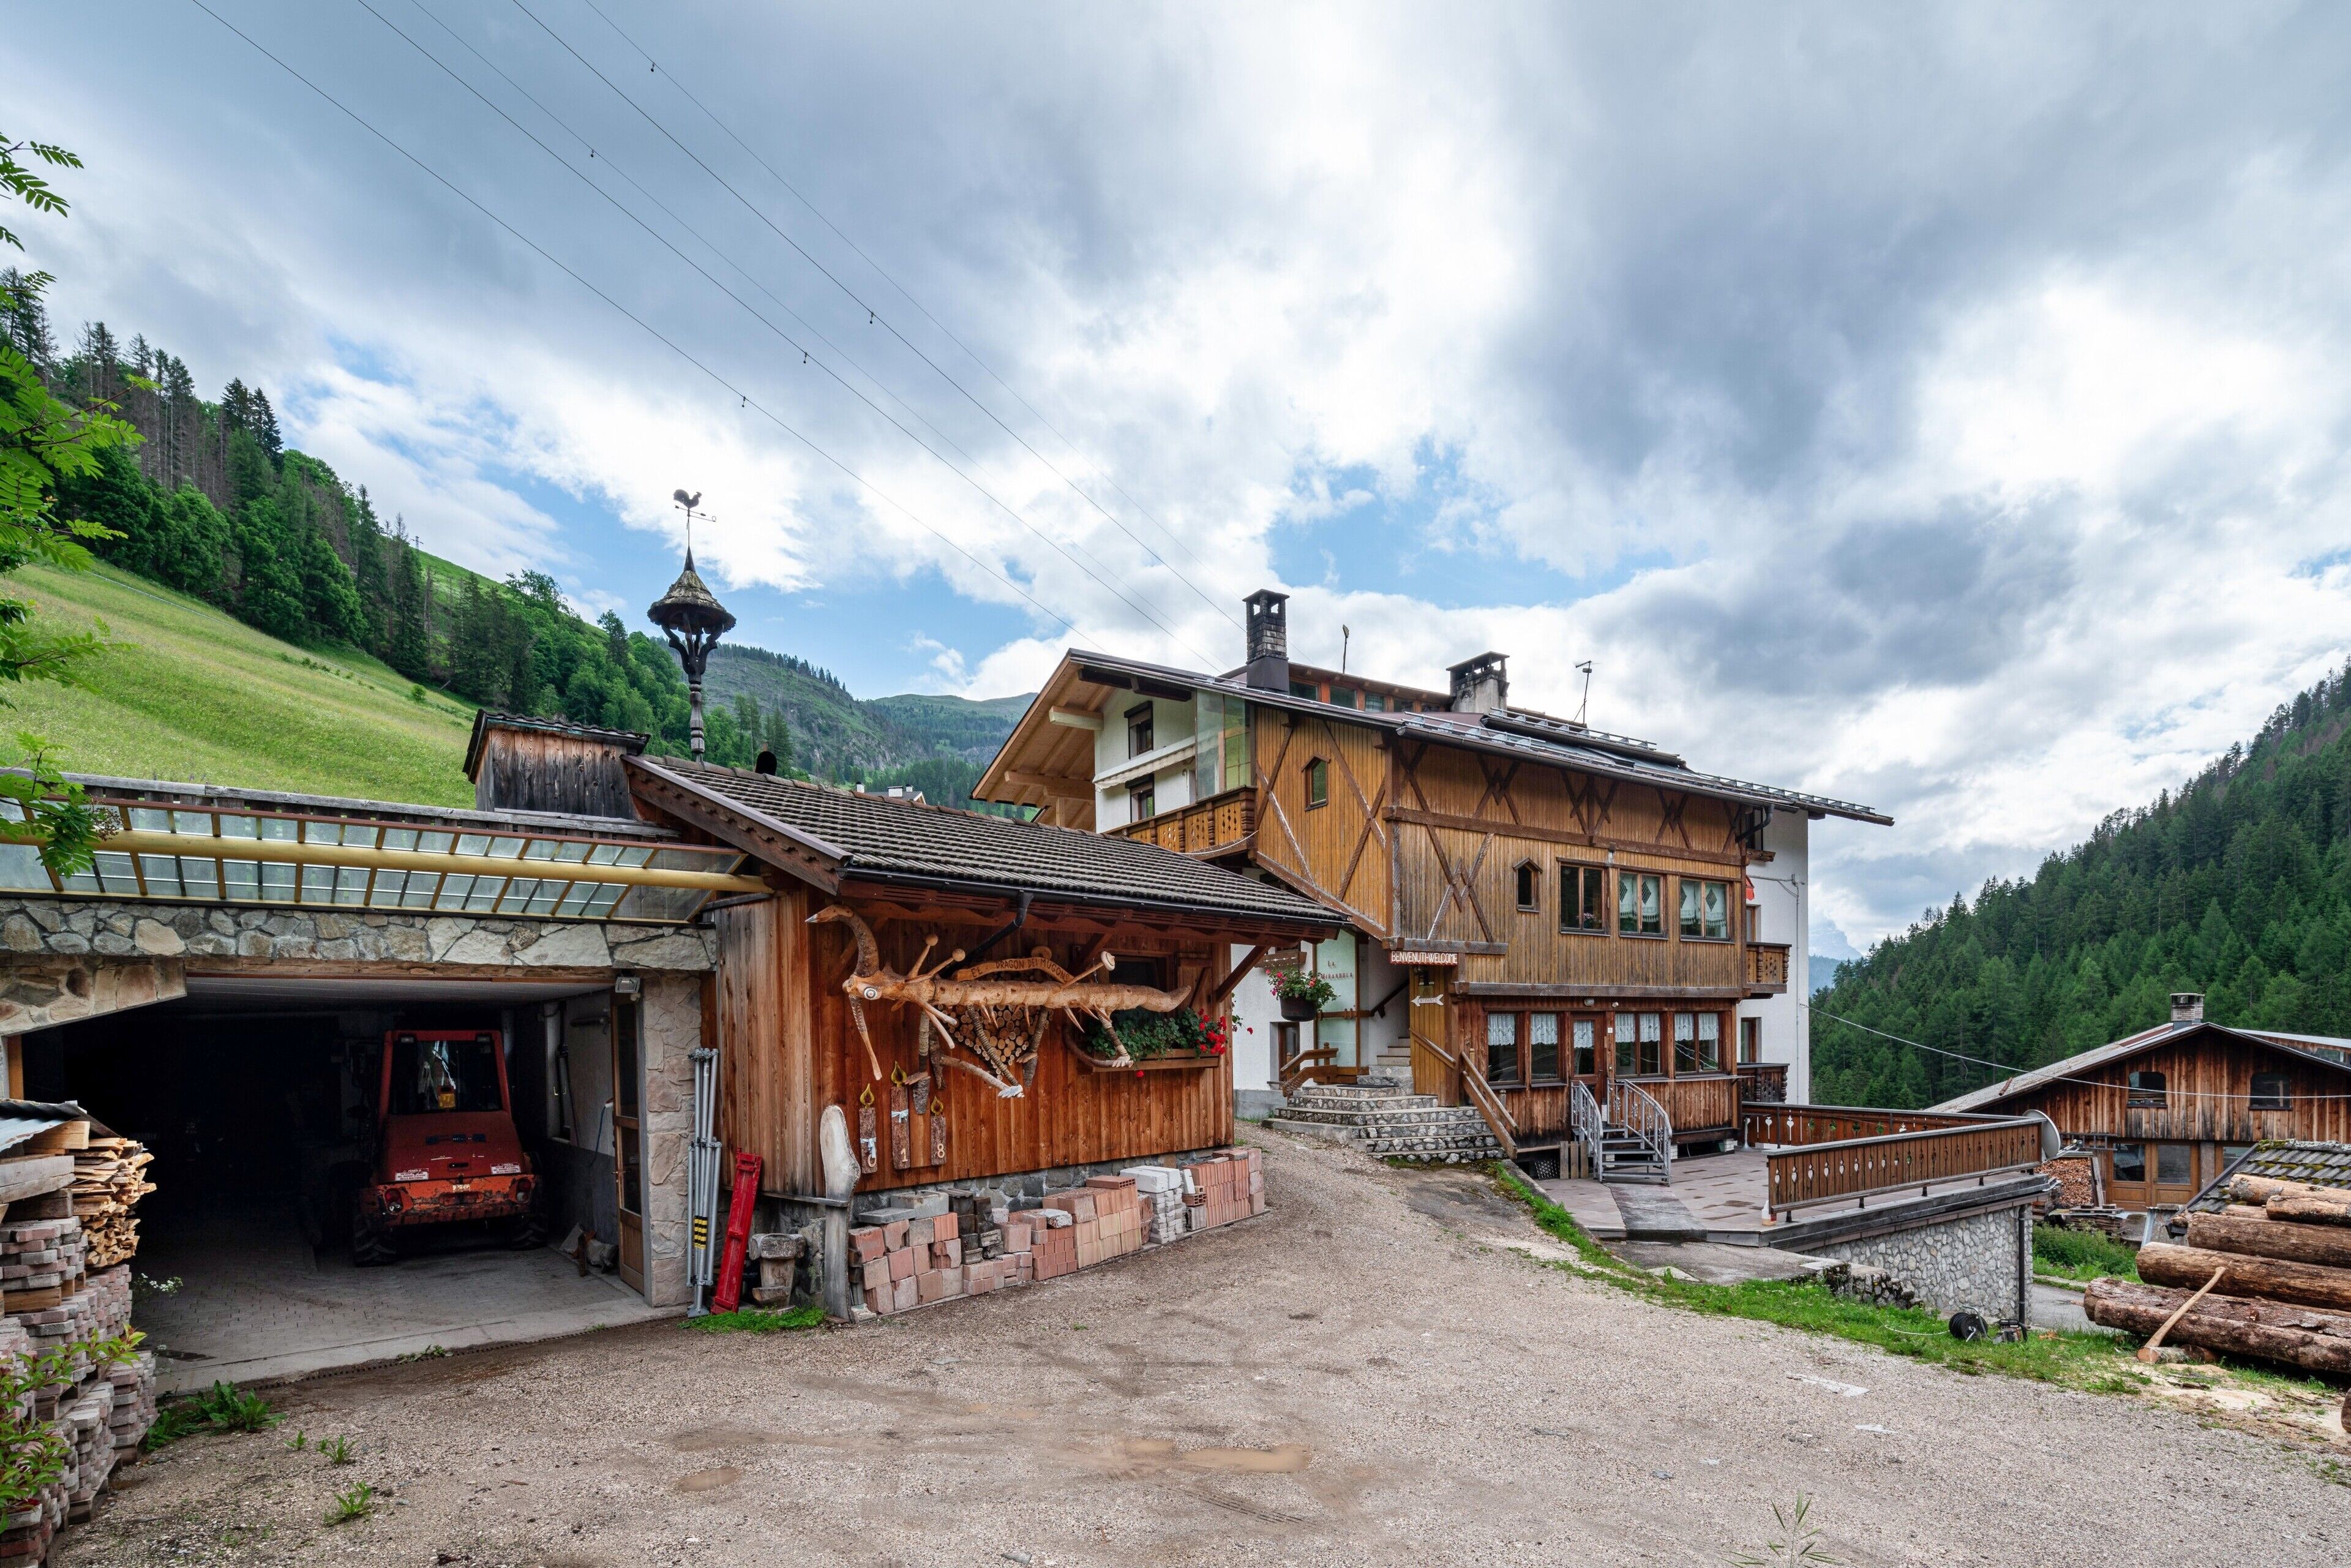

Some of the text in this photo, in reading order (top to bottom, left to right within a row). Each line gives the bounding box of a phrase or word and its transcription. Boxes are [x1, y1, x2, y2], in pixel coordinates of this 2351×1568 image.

[1391, 951, 1458, 964] BENVENUTI-WELCOME
[971, 968, 983, 977] EL
[996, 959, 1025, 969] DRAGON
[1028, 958, 1038, 967] DEI
[901, 1148, 908, 1162] 1
[937, 1143, 945, 1158] 8
